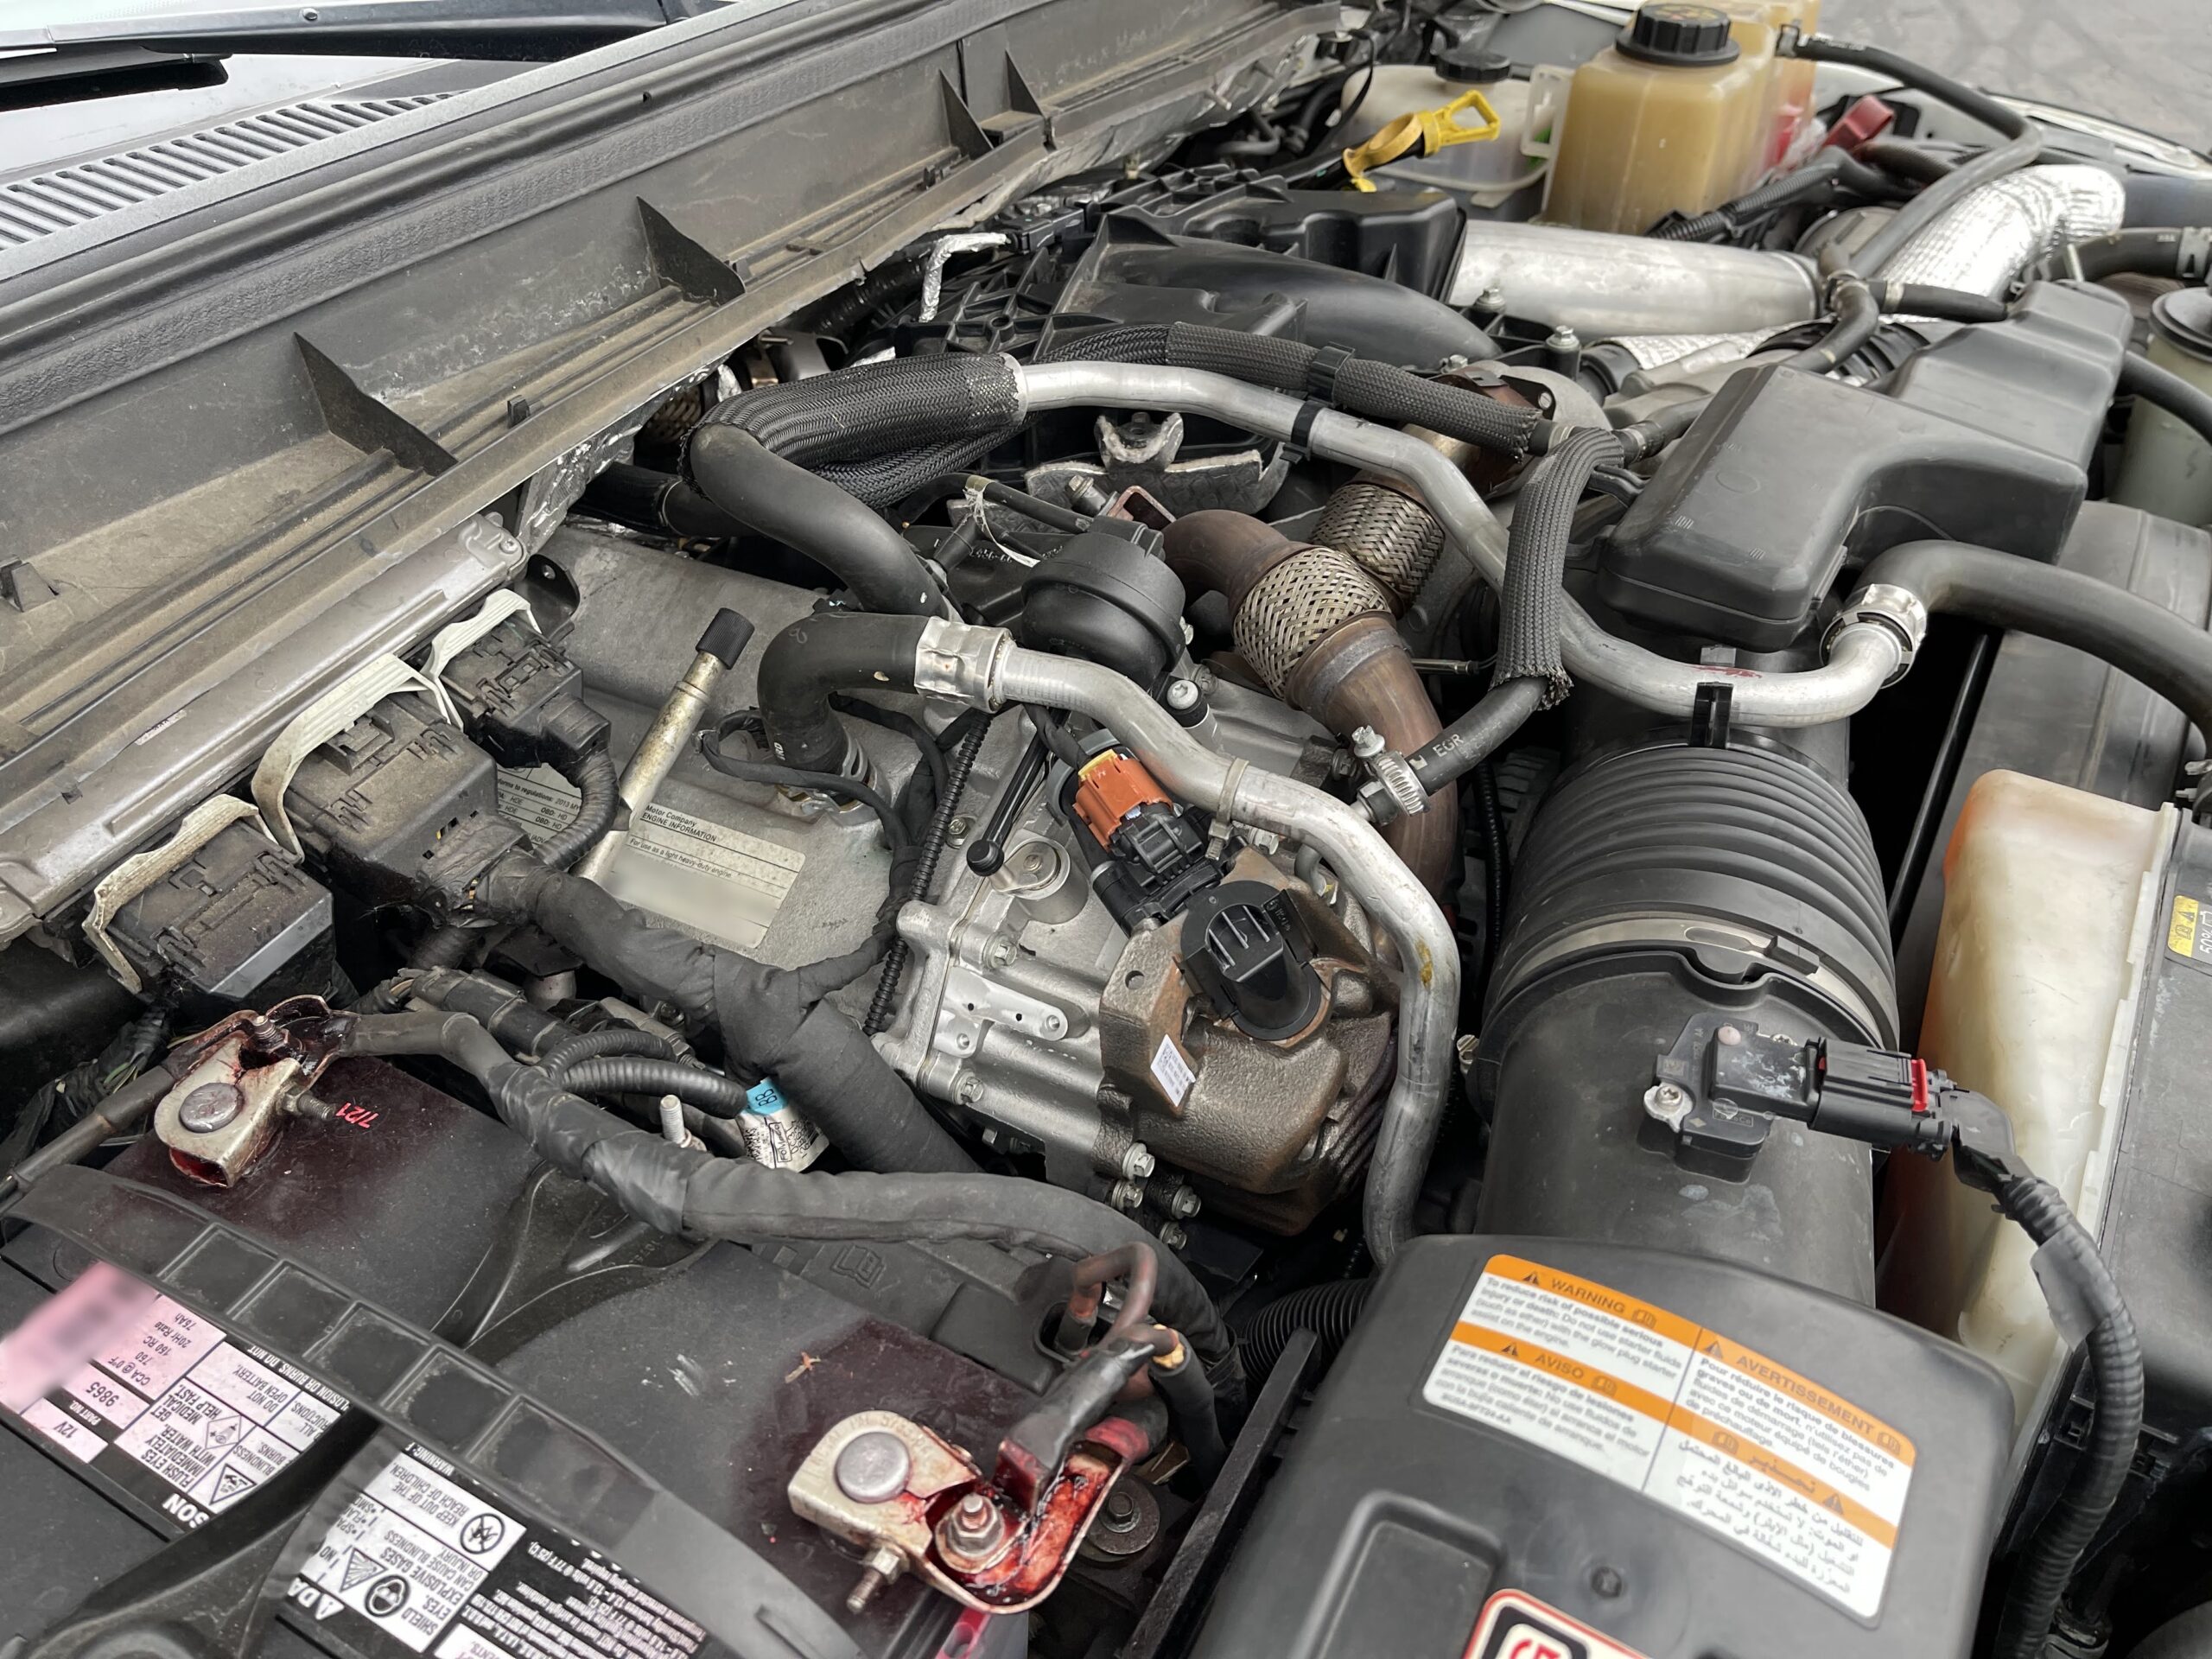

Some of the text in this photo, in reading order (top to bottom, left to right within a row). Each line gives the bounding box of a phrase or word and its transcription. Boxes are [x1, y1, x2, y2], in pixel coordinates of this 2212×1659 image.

[1433, 734, 1464, 757] EGR
[510, 796, 524, 804] HDE
[540, 807, 556, 816] OBD:
[521, 786, 554, 802] regulations:
[555, 798, 569, 807] 2013
[504, 804, 518, 814] HDE
[535, 816, 551, 825] OBD:
[642, 811, 716, 842] ENGINE INFORMATION
[645, 804, 697, 828] Motor Company
[629, 837, 641, 846] For
[664, 850, 678, 861] light
[755, 1089, 778, 1107] BB
[336, 1103, 378, 1128] 7/21
[1548, 1278, 1626, 1314] WARNING
[1485, 1276, 1663, 1347] To reduce risk of possible serious
[143, 1335, 158, 1347] RC
[152, 1320, 191, 1348] 20Hr Rate
[1480, 1286, 1682, 1368] injury or death: Do not use starter fluids
[107, 1355, 151, 1386] CCA @ 0°F
[247, 1343, 351, 1412] LOSION OR BURNS. DO NOT
[1534, 1351, 1586, 1380] AVISO
[86, 1381, 119, 1407] 9865
[232, 1363, 288, 1402] OPEN BATTERY.
[1452, 1344, 1635, 1422] Para reducir el riesgo de lesiones
[1735, 1353, 1874, 1436] AVERTISSEMENT
[67, 1400, 101, 1425] PART NO.
[150, 1404, 171, 1421] GET
[162, 1394, 202, 1424] MEDICAL
[173, 1383, 221, 1419] HELP FAST.
[246, 1389, 278, 1412] DO NOT
[1686, 1397, 1700, 1411] de
[1700, 1357, 1896, 1468] Pour réduire le risque de blessures
[54, 1420, 78, 1438] 12V
[298, 1422, 316, 1437] ALL
[1696, 1367, 1888, 1477] graves ou de mort, n'utilisez pas de
[145, 1433, 205, 1477] IMMEDIATELY
[157, 1423, 216, 1465] WITH WATER.
[255, 1441, 286, 1465] BURNS.
[1689, 1388, 1871, 1492] avec ce moteur équipé de bougies
[141, 1449, 194, 1487] FLUSH EYES
[232, 1444, 275, 1476] BLINDNESS
[411, 1444, 454, 1476] WARNING:
[388, 1462, 468, 1516] REACH OF CHILDREN.
[392, 1481, 459, 1527] KEEP OUT OF THE
[318, 1545, 337, 1560] NO
[384, 1529, 474, 1591] CAN CAUSE BLINDNESS
[436, 1547, 483, 1580] OR INJURY.
[379, 1547, 464, 1605] EXPLOSIVE GASES
[401, 1607, 438, 1635] SHIELD
[419, 1595, 451, 1619] EYES.
